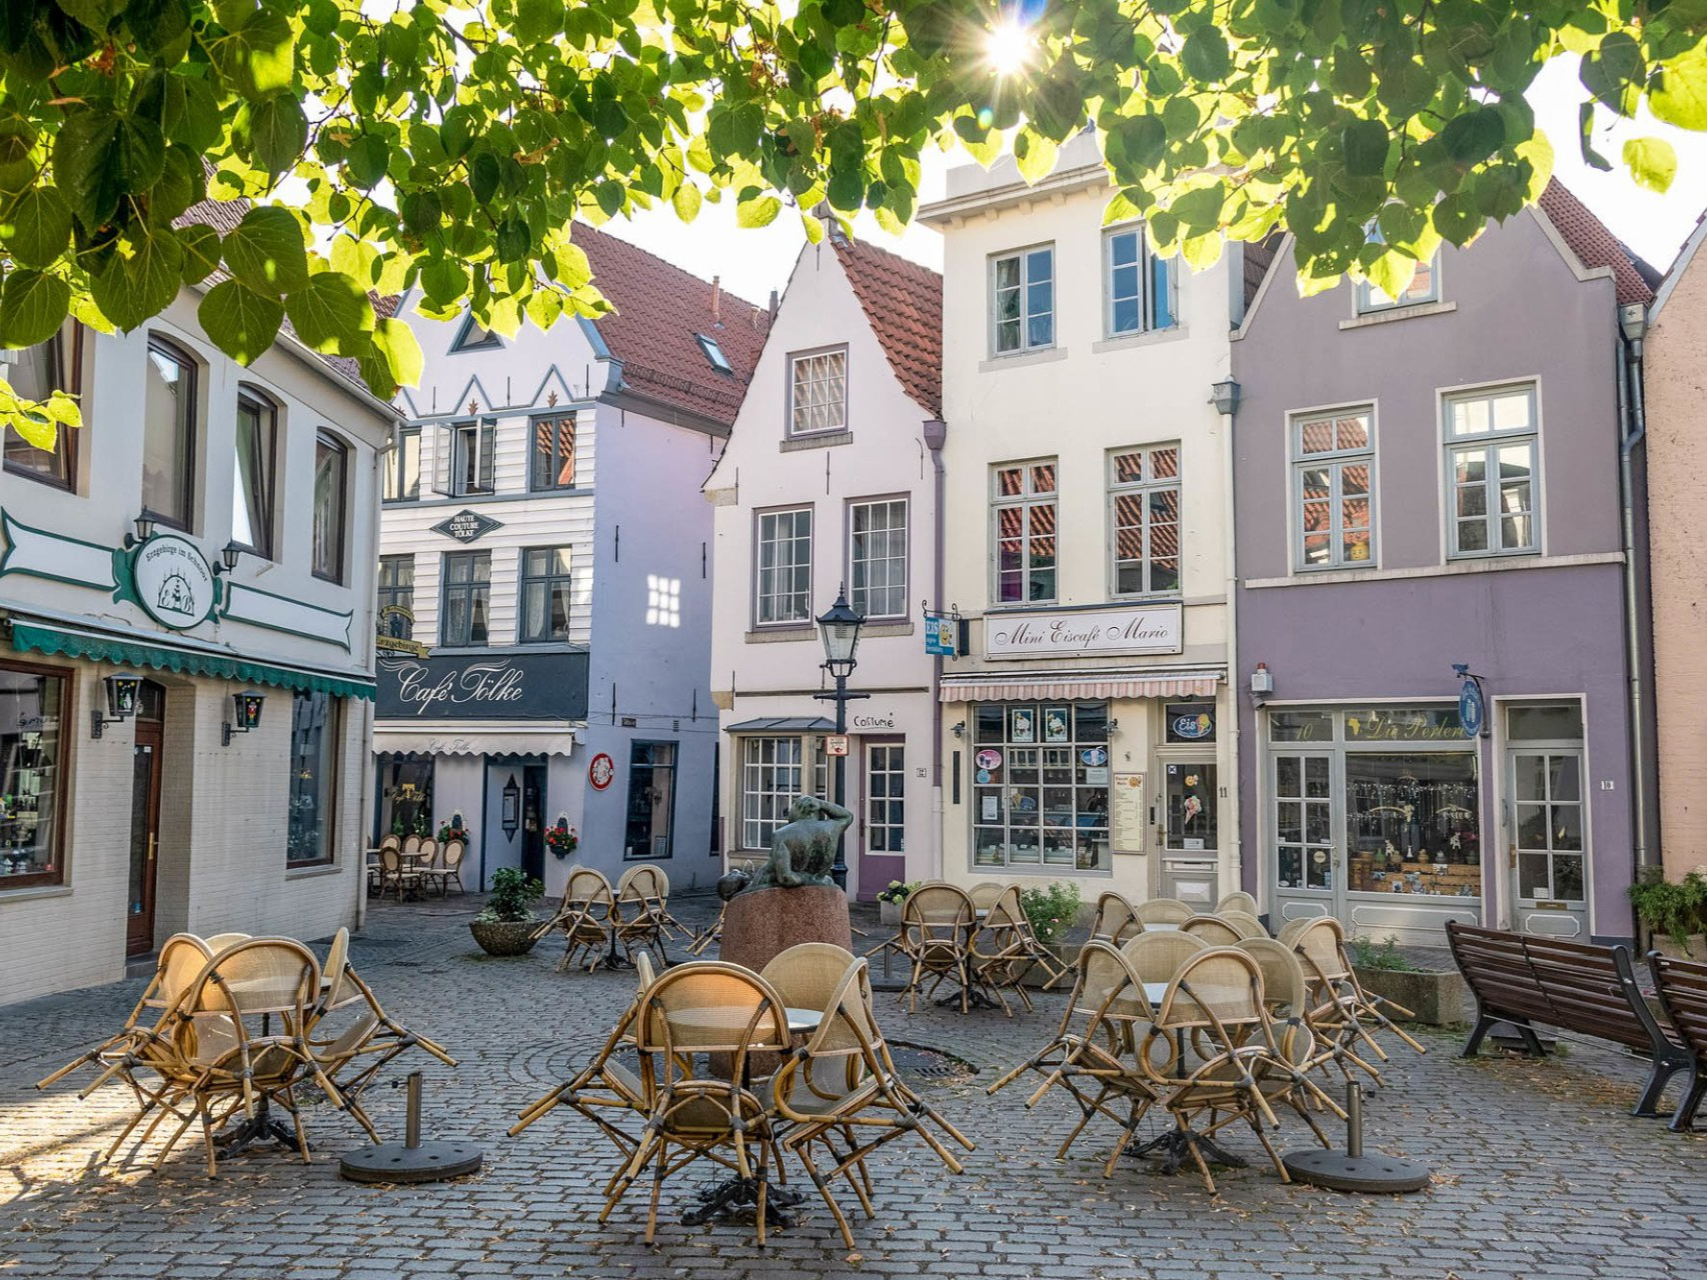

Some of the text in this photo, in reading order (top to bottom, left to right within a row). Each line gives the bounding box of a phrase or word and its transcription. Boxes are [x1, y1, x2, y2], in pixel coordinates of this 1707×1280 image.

[449, 521, 480, 531] COUTURE
[994, 616, 1168, 648] Mini Eiscafé Mario
[392, 659, 525, 715] Café Tölke
[1178, 717, 1196, 731] Eis
[1296, 723, 1314, 740] 10
[1218, 785, 1228, 798] 11
